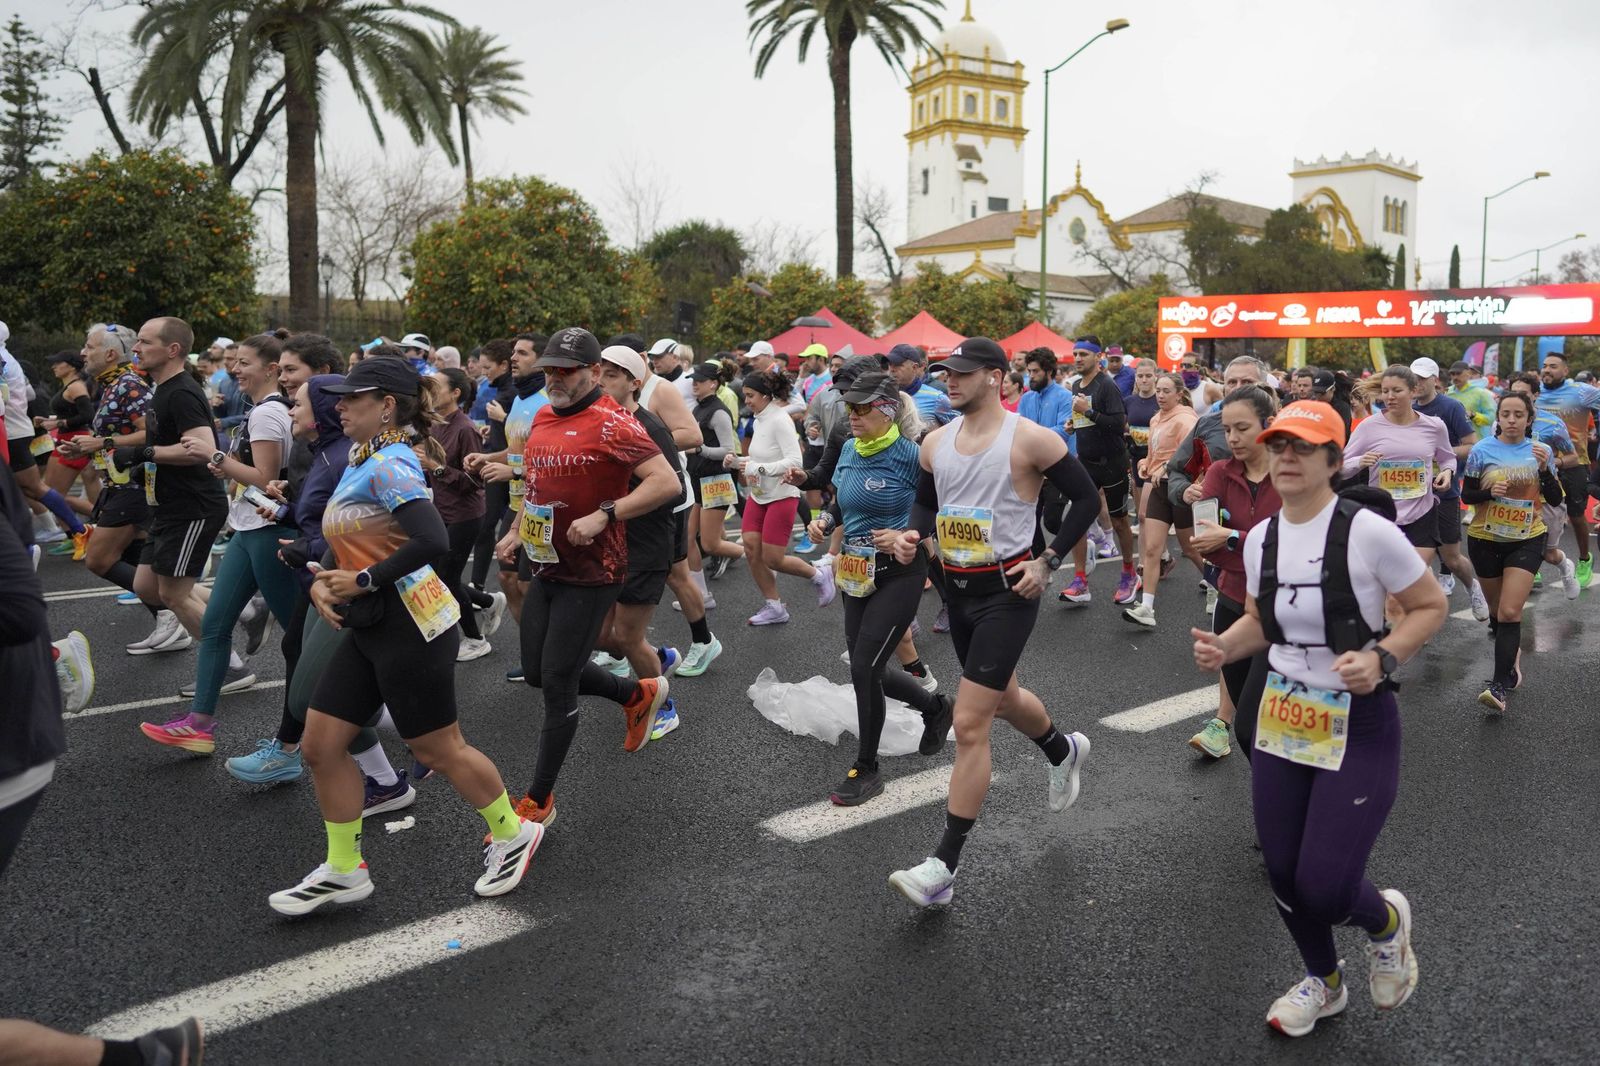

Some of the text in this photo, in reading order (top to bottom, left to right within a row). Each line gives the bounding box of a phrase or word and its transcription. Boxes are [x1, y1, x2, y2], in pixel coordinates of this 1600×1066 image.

[1431, 296, 1505, 313] maratón
[532, 452, 599, 468] MARATÓN
[1383, 470, 1418, 483] 14551
[703, 481, 731, 494] 18790
[1491, 504, 1526, 522] 16129
[941, 520, 982, 542] 14990
[1269, 695, 1329, 732] 16931
